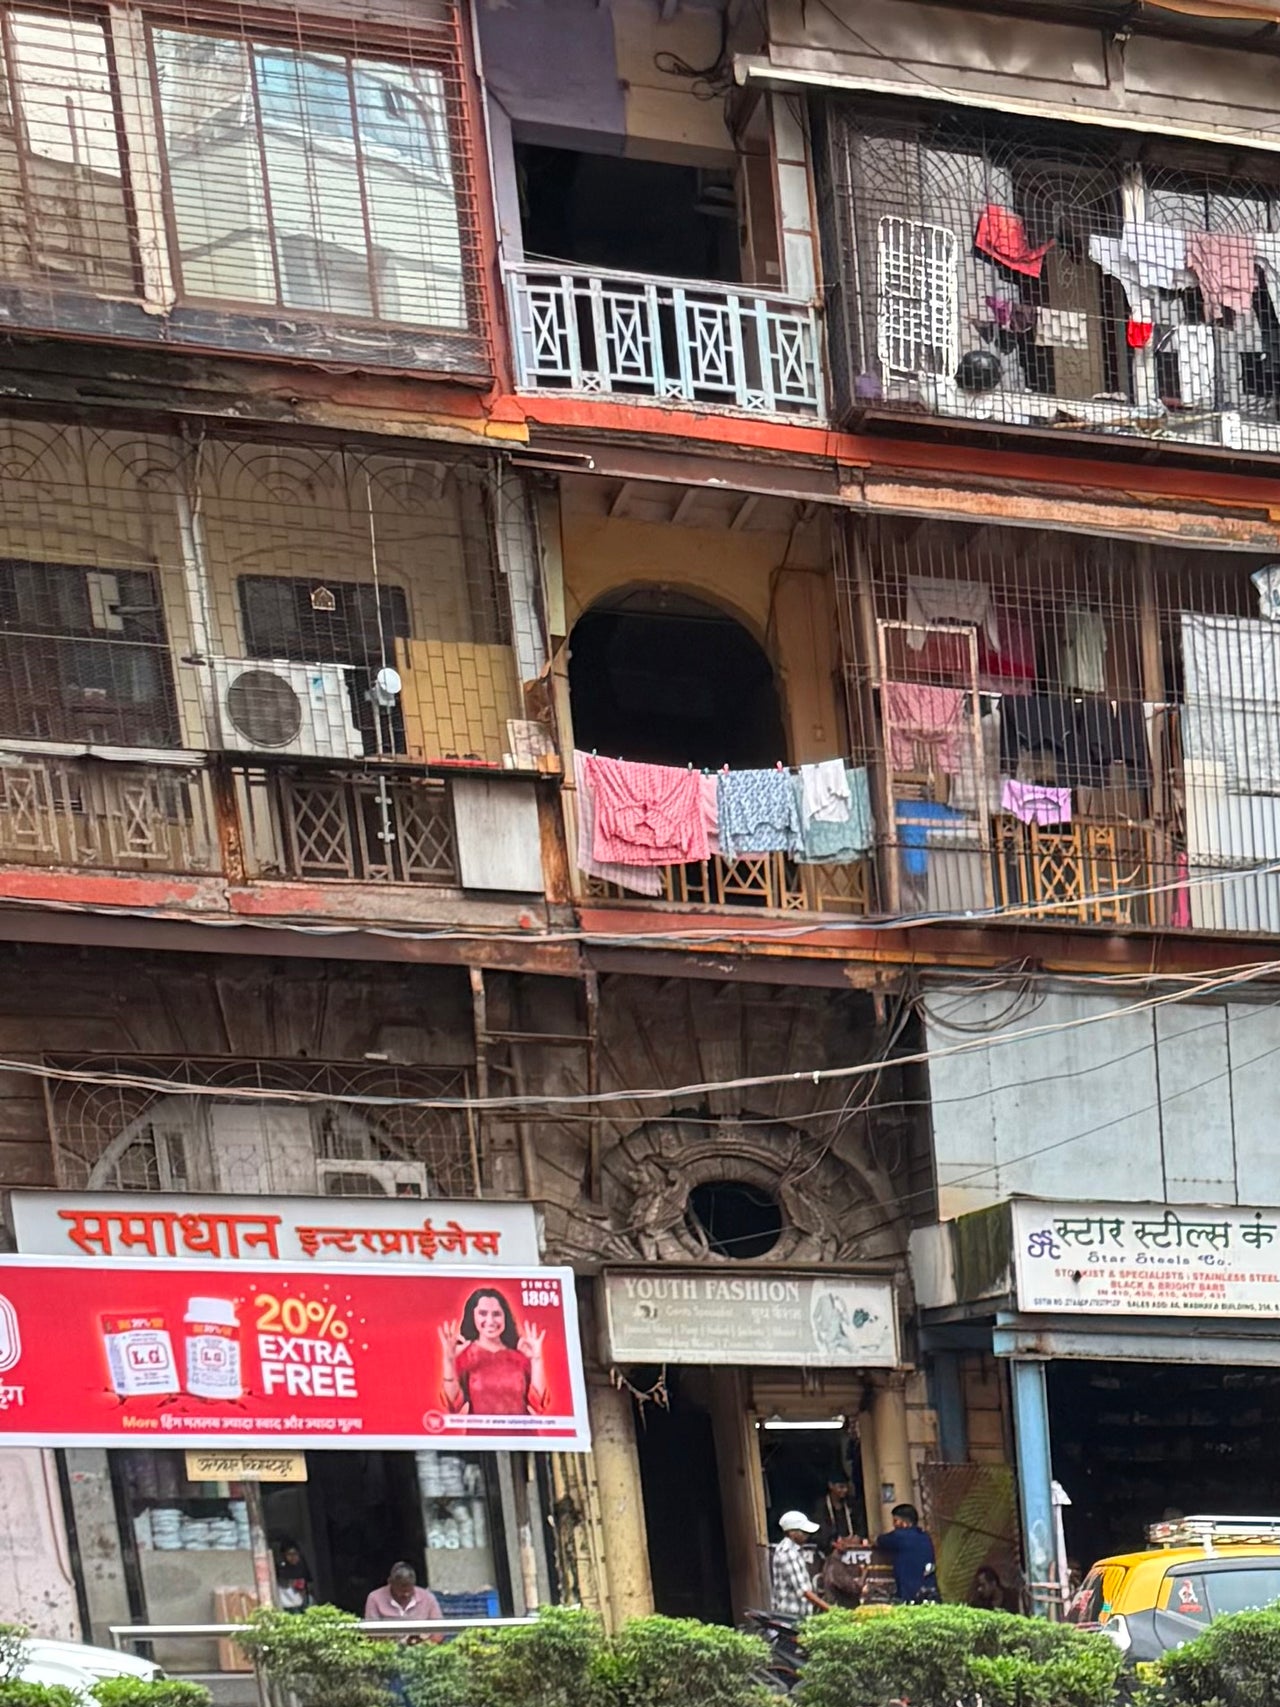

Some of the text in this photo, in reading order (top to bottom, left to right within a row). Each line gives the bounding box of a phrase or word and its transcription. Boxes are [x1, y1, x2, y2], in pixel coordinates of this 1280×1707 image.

[57, 1210, 282, 1260] समाधान
[1053, 1217, 1126, 1248] स्टार
[1132, 1210, 1233, 1251] स्टील्स
[1087, 1251, 1127, 1264] Star
[520, 1280, 559, 1290] SINCE
[1054, 1268, 1105, 1279] STOKIST
[1118, 1269, 1185, 1281] SPECIALISTS
[1192, 1271, 1247, 1283] STAINLESS
[1249, 1273, 1280, 1283] STEEL
[1110, 1280, 1144, 1290] BLACK
[1157, 1281, 1196, 1291] BRIGHT
[624, 1277, 802, 1302] YOUTH FASHION
[253, 1294, 349, 1340] 20%
[257, 1333, 354, 1367] EXTRA
[261, 1361, 359, 1399] FREE
[122, 1416, 158, 1430] More
